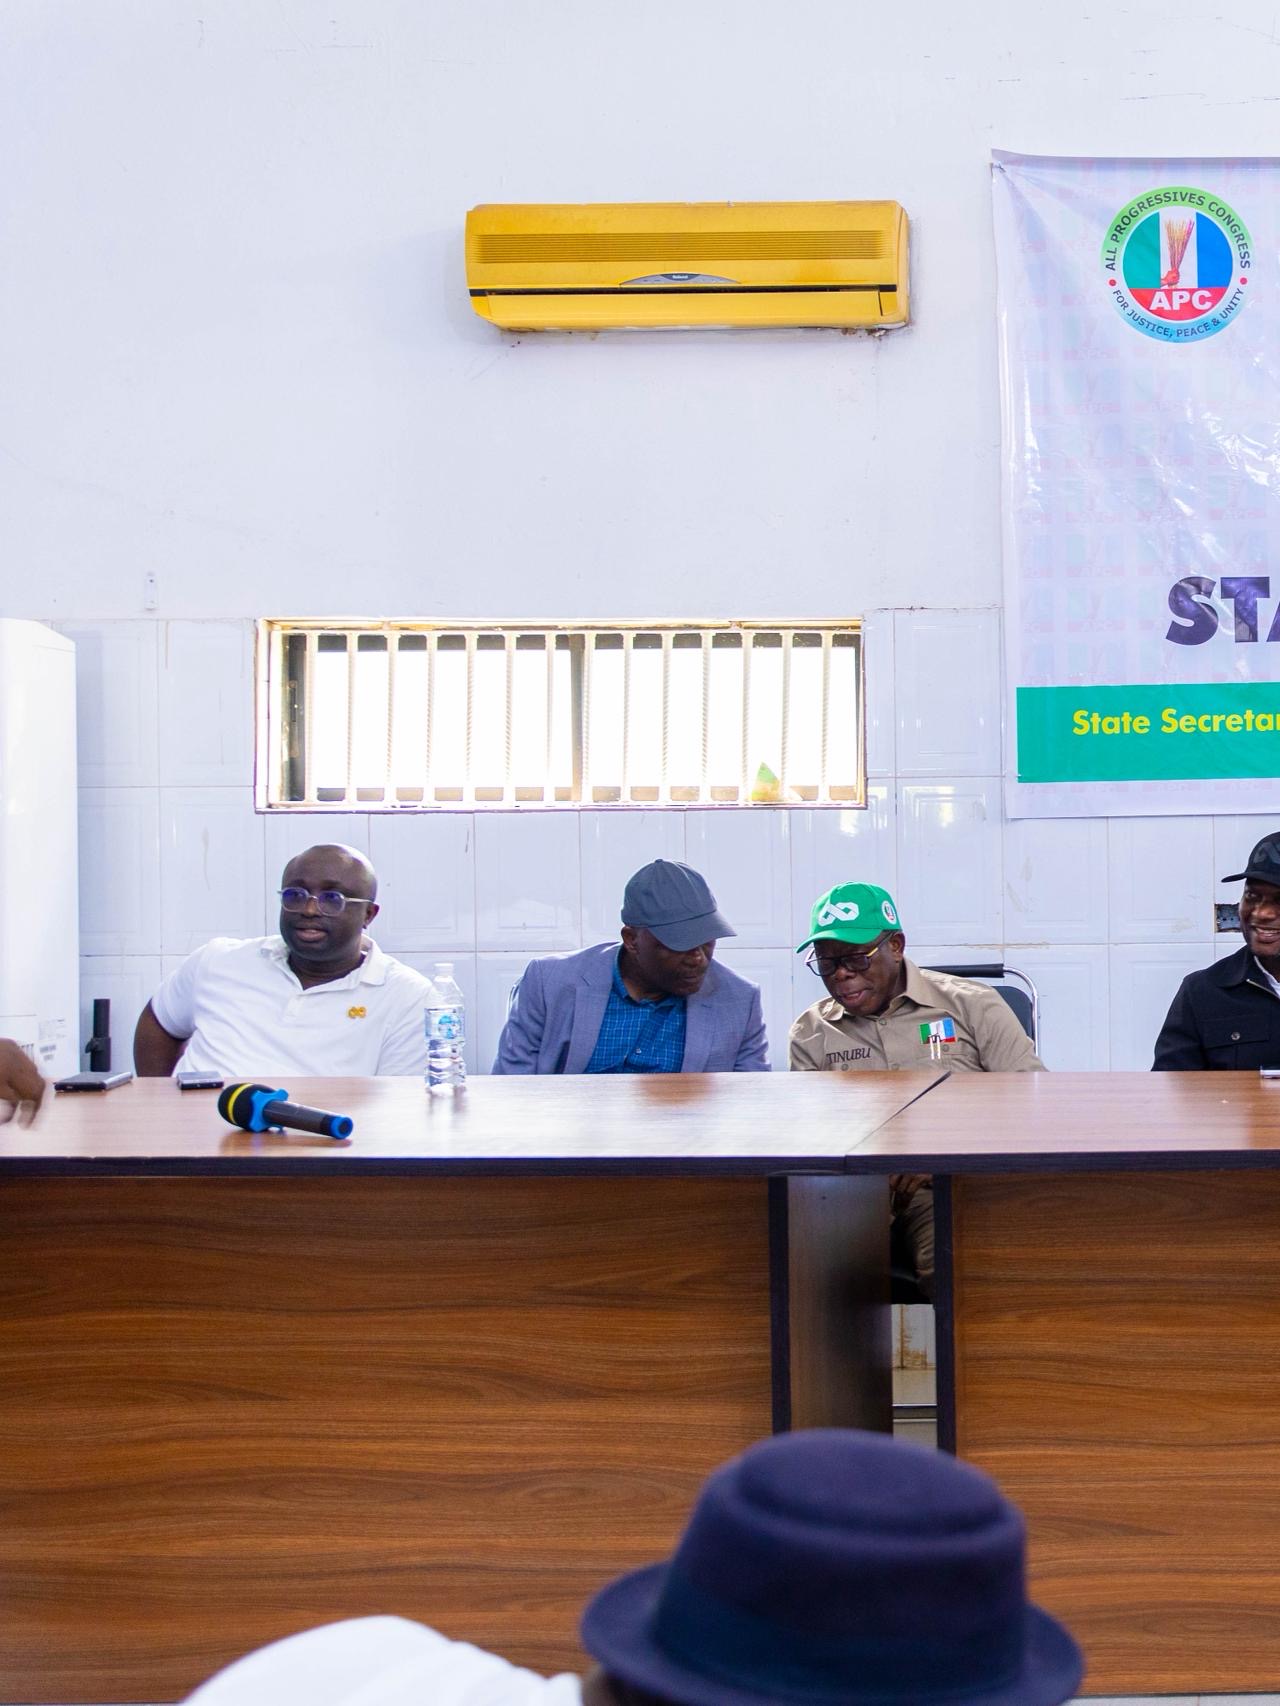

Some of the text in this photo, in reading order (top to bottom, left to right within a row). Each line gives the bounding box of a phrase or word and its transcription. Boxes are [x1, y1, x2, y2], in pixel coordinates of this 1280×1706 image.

[1105, 191, 1250, 271] ALL PROGRESSIVES CONGRESS
[1113, 288, 1244, 338] FOR JUSTICE, PEACE & UNITY
[1150, 290, 1213, 311] APC
[1072, 710, 1150, 736] State
[826, 1047, 871, 1064] TINUBU
